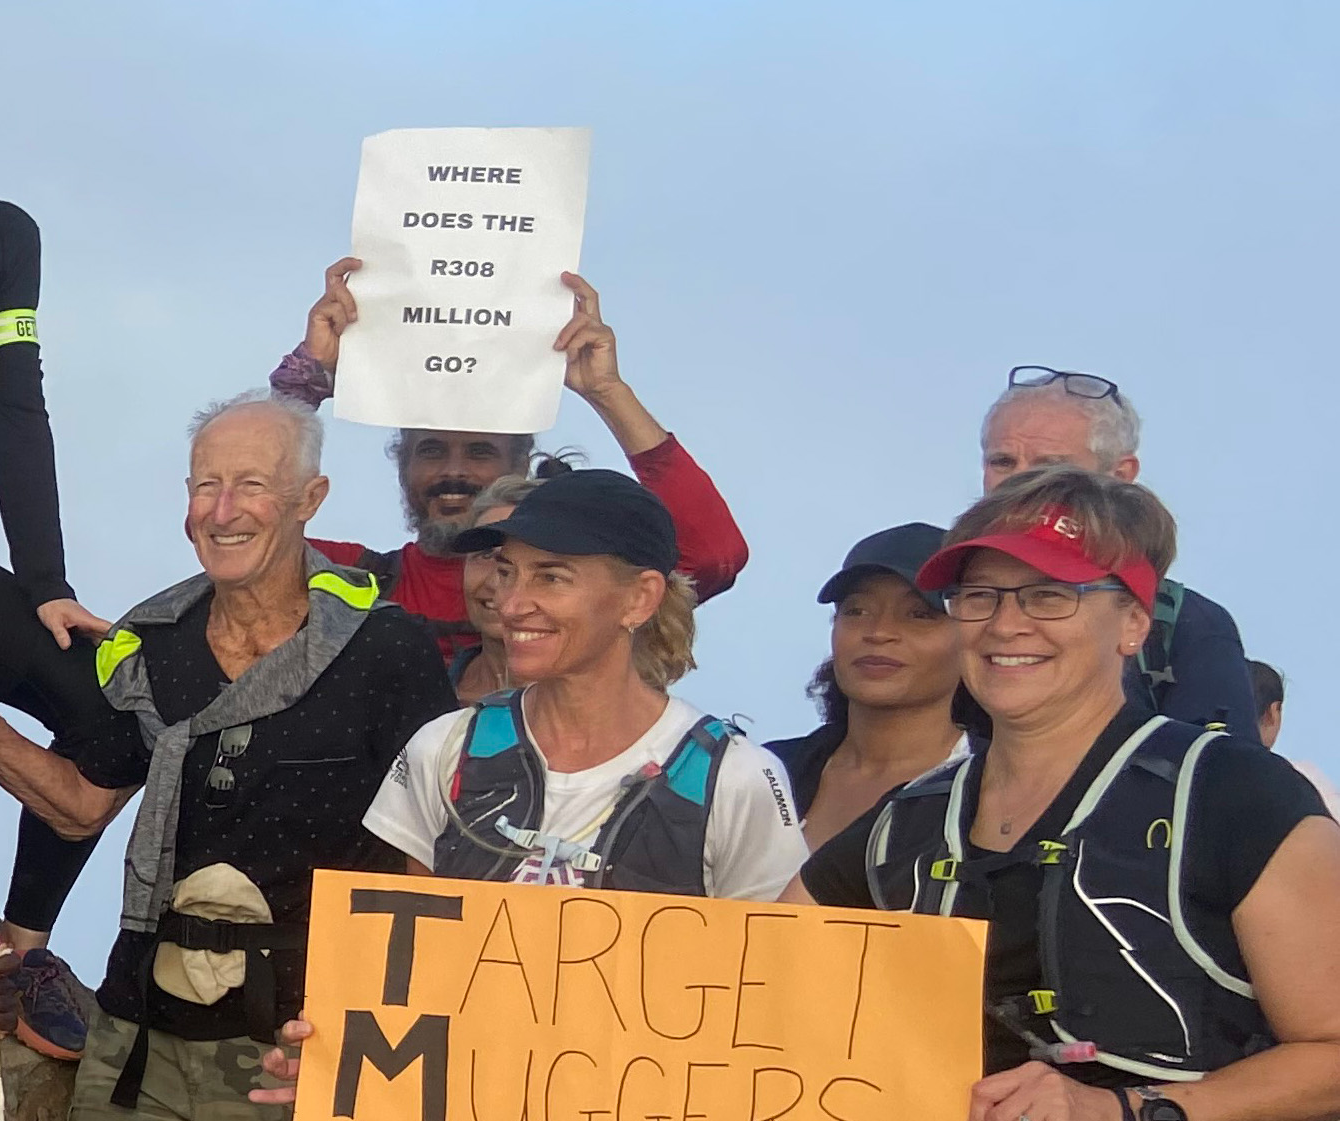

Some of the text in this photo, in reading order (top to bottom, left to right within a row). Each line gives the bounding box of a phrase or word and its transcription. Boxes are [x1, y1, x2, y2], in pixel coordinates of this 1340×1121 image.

[427, 165, 522, 185] WHERE
[402, 211, 535, 233] DOES THE
[430, 259, 495, 278] R308
[402, 306, 512, 326] MILLION
[424, 355, 477, 374] GO?
[762, 768, 792, 826] SALOMON
[350, 888, 901, 1060] TARGET
